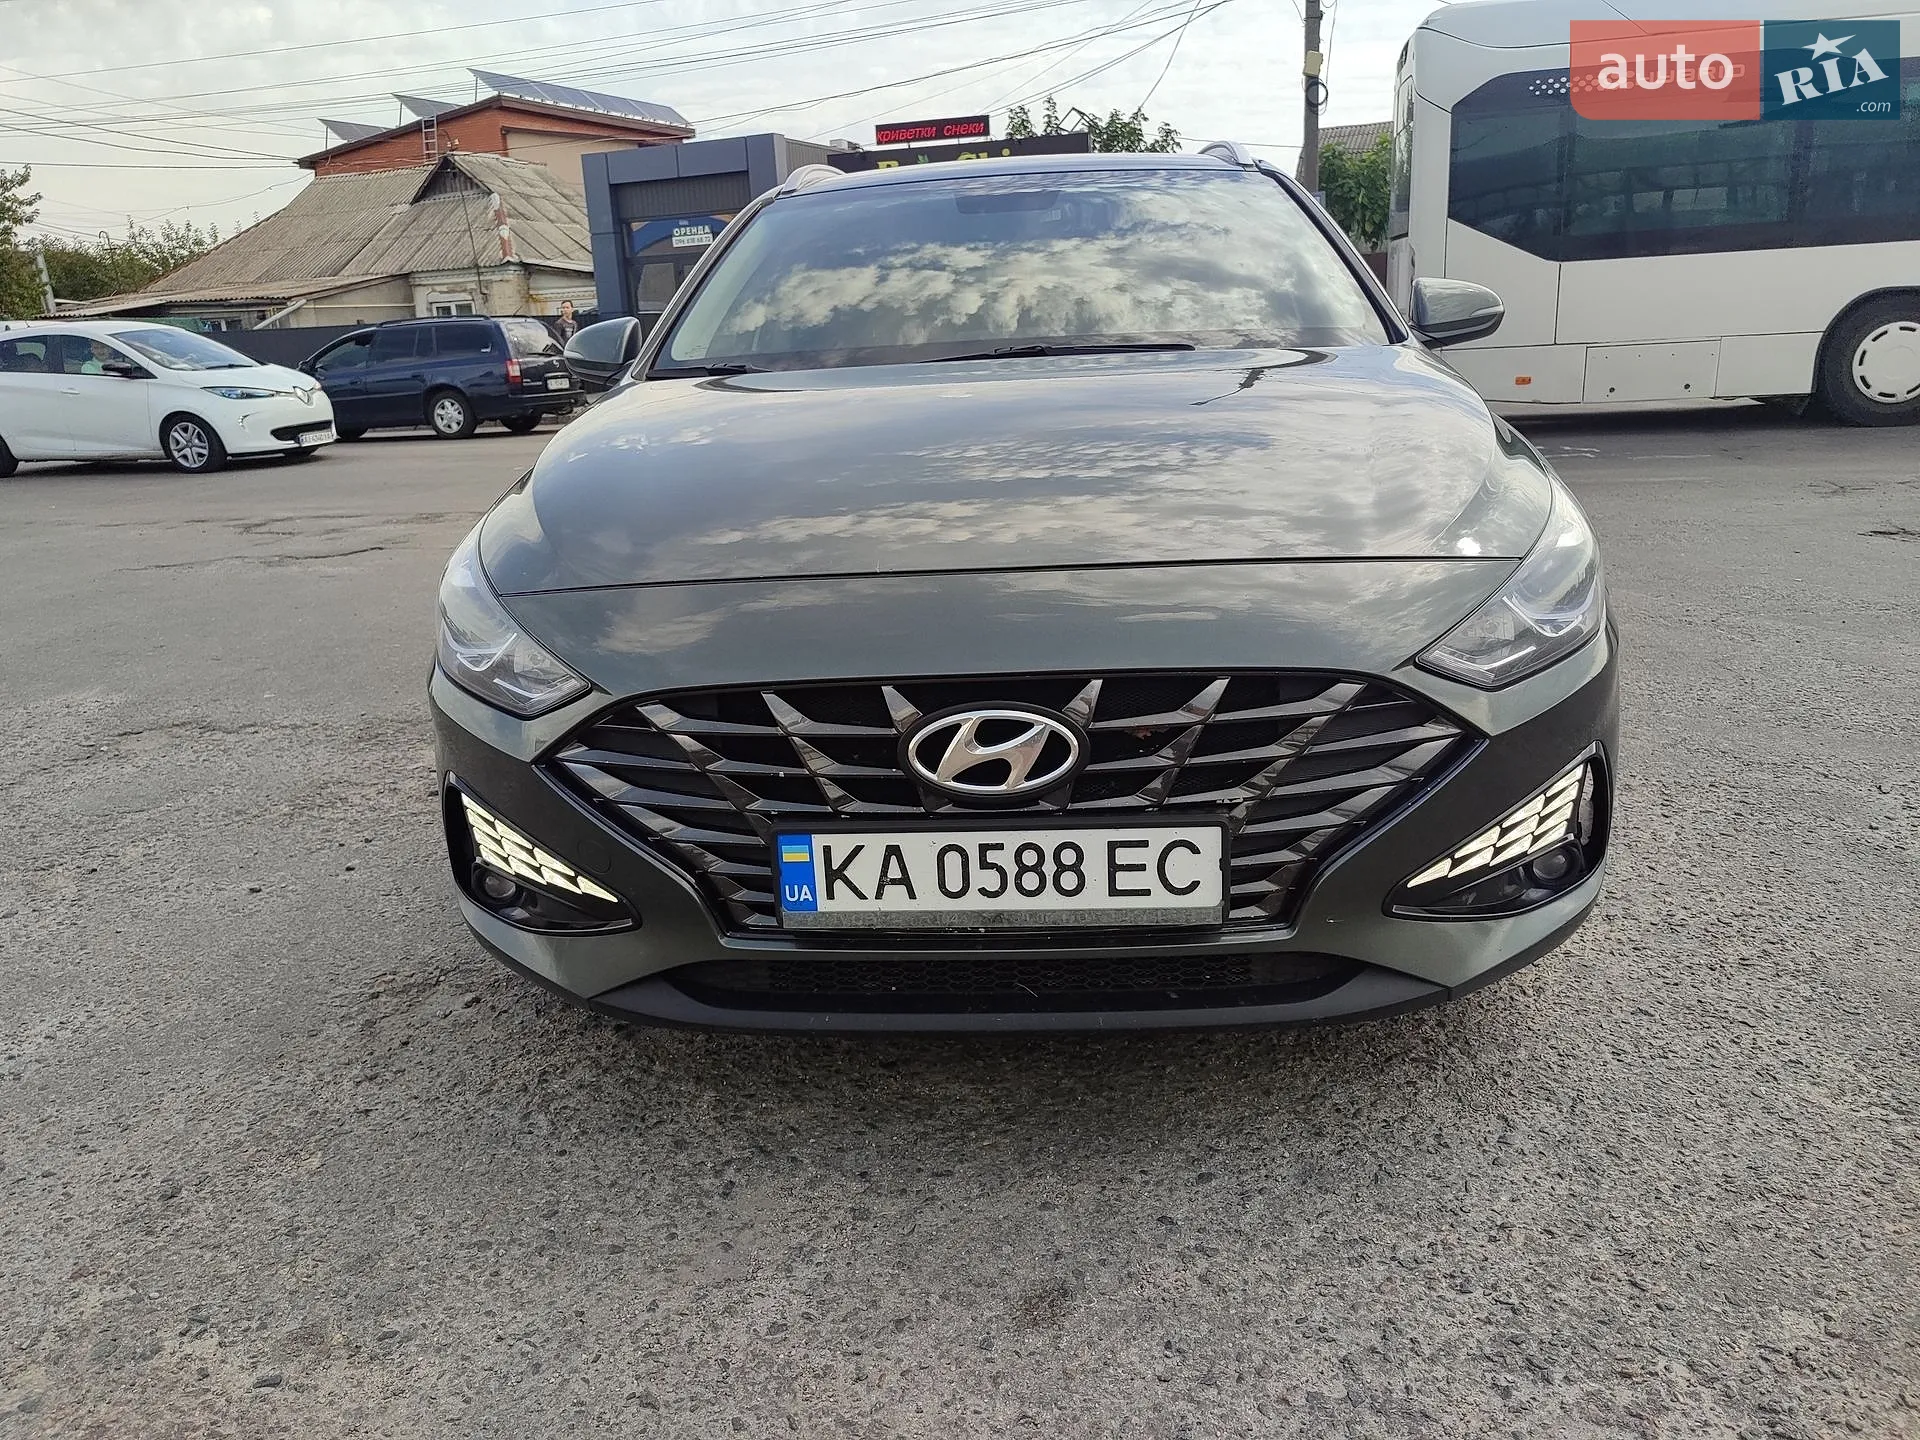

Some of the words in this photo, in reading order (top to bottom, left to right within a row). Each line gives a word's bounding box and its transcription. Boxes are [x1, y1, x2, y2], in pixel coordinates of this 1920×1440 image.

[673, 225, 711, 236] ОРЕНДА
[822, 844, 917, 900] KA
[936, 841, 1086, 899] 0588
[1107, 839, 1201, 897] EC
[785, 884, 813, 902] UA
